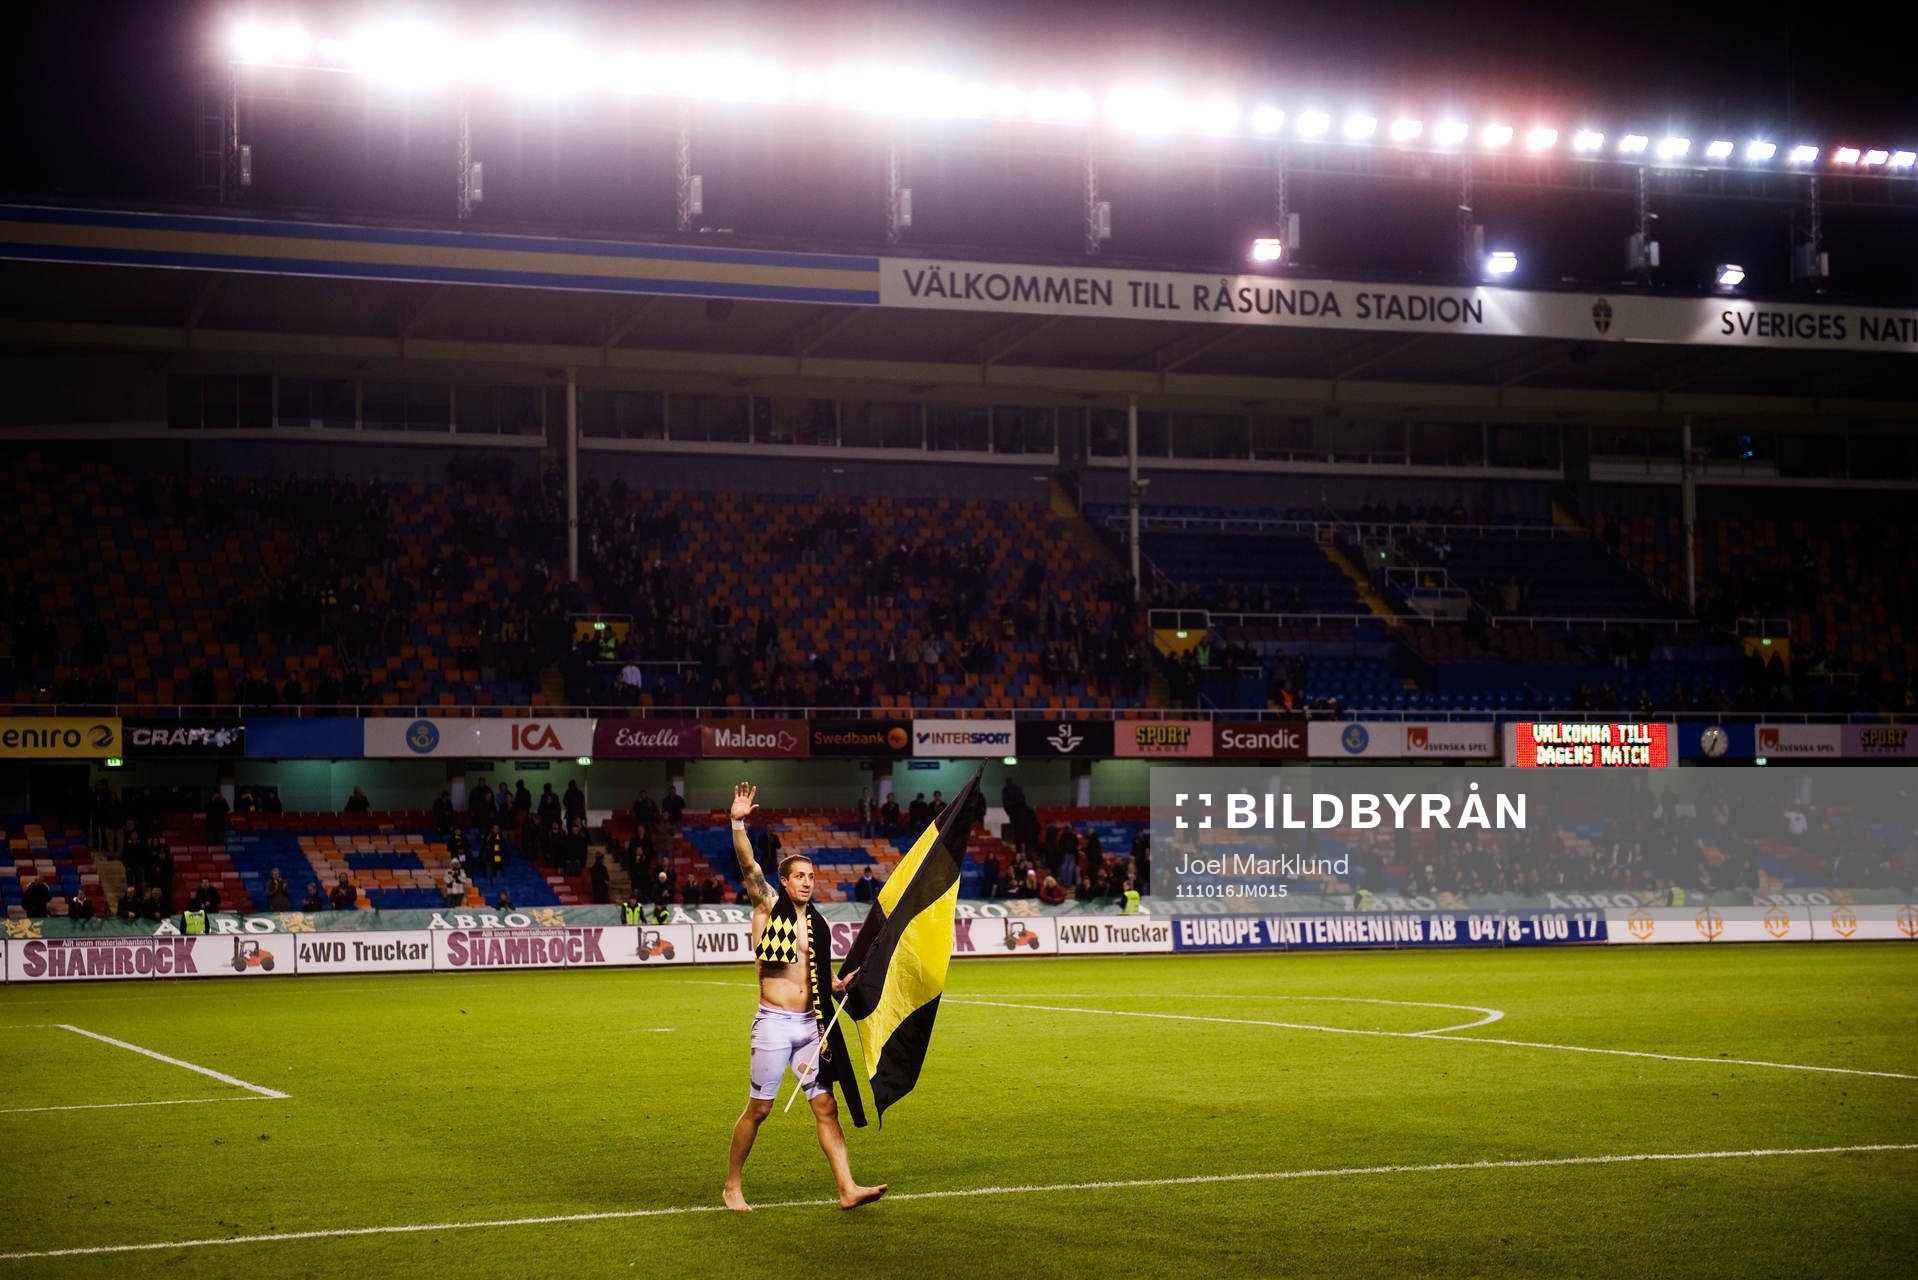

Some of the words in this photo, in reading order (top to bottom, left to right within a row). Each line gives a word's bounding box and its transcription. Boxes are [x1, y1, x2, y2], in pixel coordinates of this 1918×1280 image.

[903, 265, 1112, 305] VÄLKOMMEN
[1129, 280, 1180, 310] TILL
[1194, 276, 1342, 317] RÅSUNDA
[1357, 292, 1483, 325] STADION
[1721, 309, 1847, 340] SVERIGES
[3, 729, 81, 749] eniro
[133, 730, 214, 746] CRAFT
[512, 724, 563, 751] ICA
[615, 728, 680, 747] Estrella
[715, 723, 777, 748] Malaco
[815, 731, 886, 746] Swedbank
[931, 733, 1011, 745] INTERSPORT
[1058, 724, 1072, 738] SJ
[1137, 727, 1190, 745] SPORT
[1221, 729, 1300, 749] Scandic
[1618, 725, 1652, 744] TILL
[1861, 728, 1907, 746] SPORT
[1429, 744, 1465, 752] SVENSKA
[1469, 744, 1488, 752] SPEL
[1601, 746, 1650, 765] MATCH
[1779, 744, 1815, 752] SVENSKA
[1816, 744, 1835, 752] SPEL
[427, 910, 531, 929] ÅBRO
[670, 905, 754, 924] ÅBR
[153, 918, 275, 935] ÅRO
[1060, 926, 1099, 944] 4WD
[1104, 924, 1169, 943] Truckar
[1181, 917, 1260, 946] EUROPE
[1265, 914, 1423, 944] VATTENRENING
[1429, 914, 1457, 942] AB
[1574, 911, 1597, 940] 17
[299, 942, 346, 963] 4WD
[353, 940, 429, 962] Truckar
[447, 928, 605, 967] SHAMROCK
[697, 932, 739, 954] 4WD
[23, 937, 198, 978] SHAMROCK
